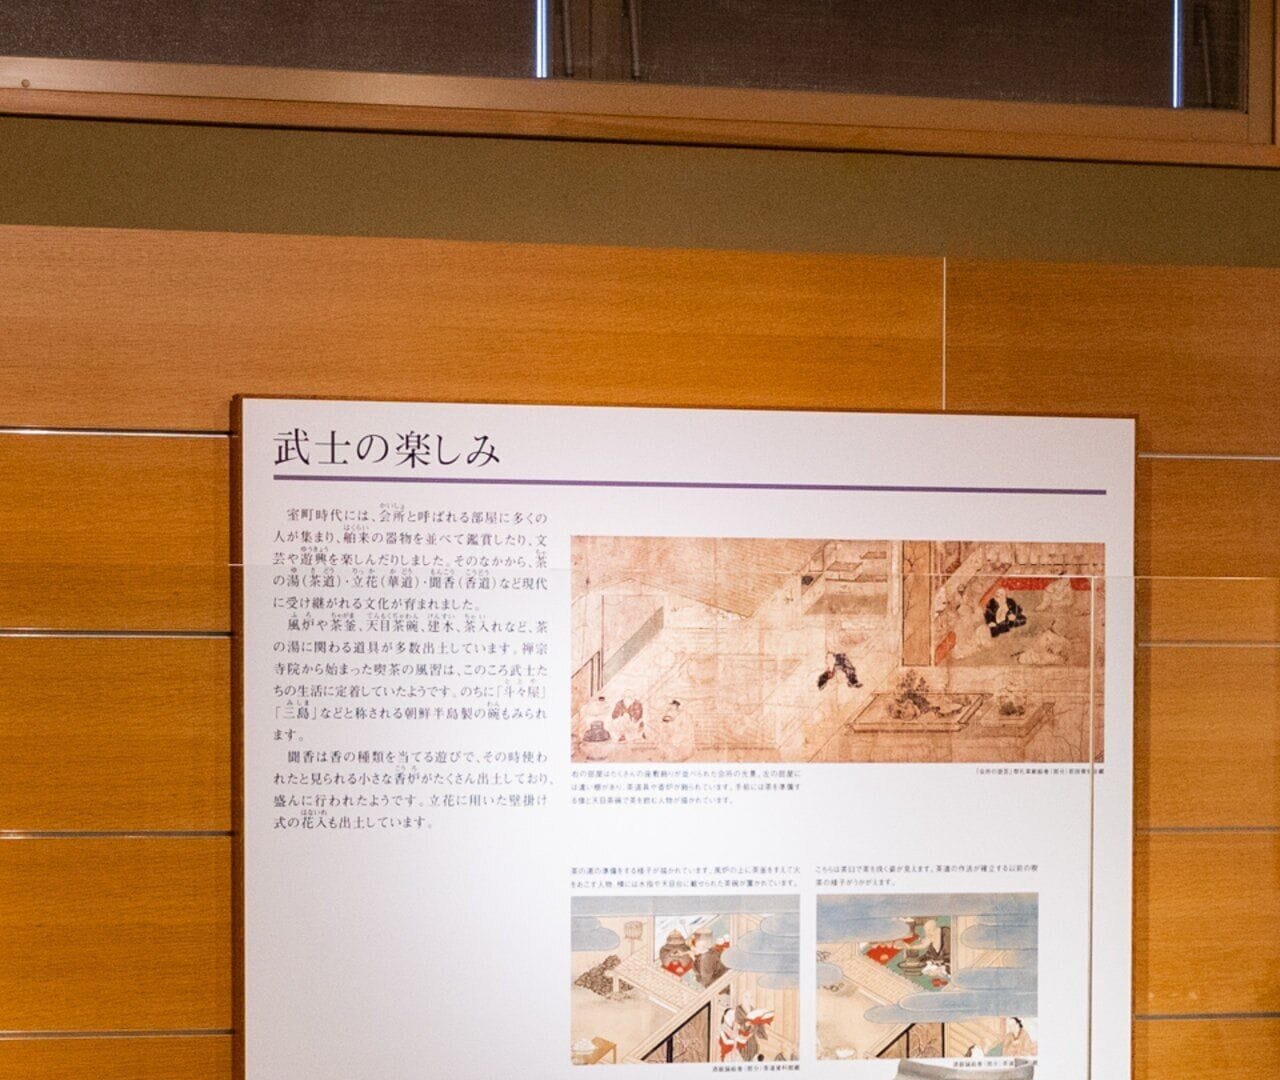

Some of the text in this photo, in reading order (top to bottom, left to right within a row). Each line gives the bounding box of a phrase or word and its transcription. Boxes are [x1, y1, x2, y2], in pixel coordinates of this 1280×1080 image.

[273, 427, 501, 469] 武士の楽しみ
[286, 507, 548, 525] 室町時代には、会所と呼ばれる部屋に多くの
[273, 596, 480, 611] に受け継がれる文化が育まれました。
[273, 728, 304, 742] ます。
[273, 816, 432, 830] 式の花入も出土しています。
